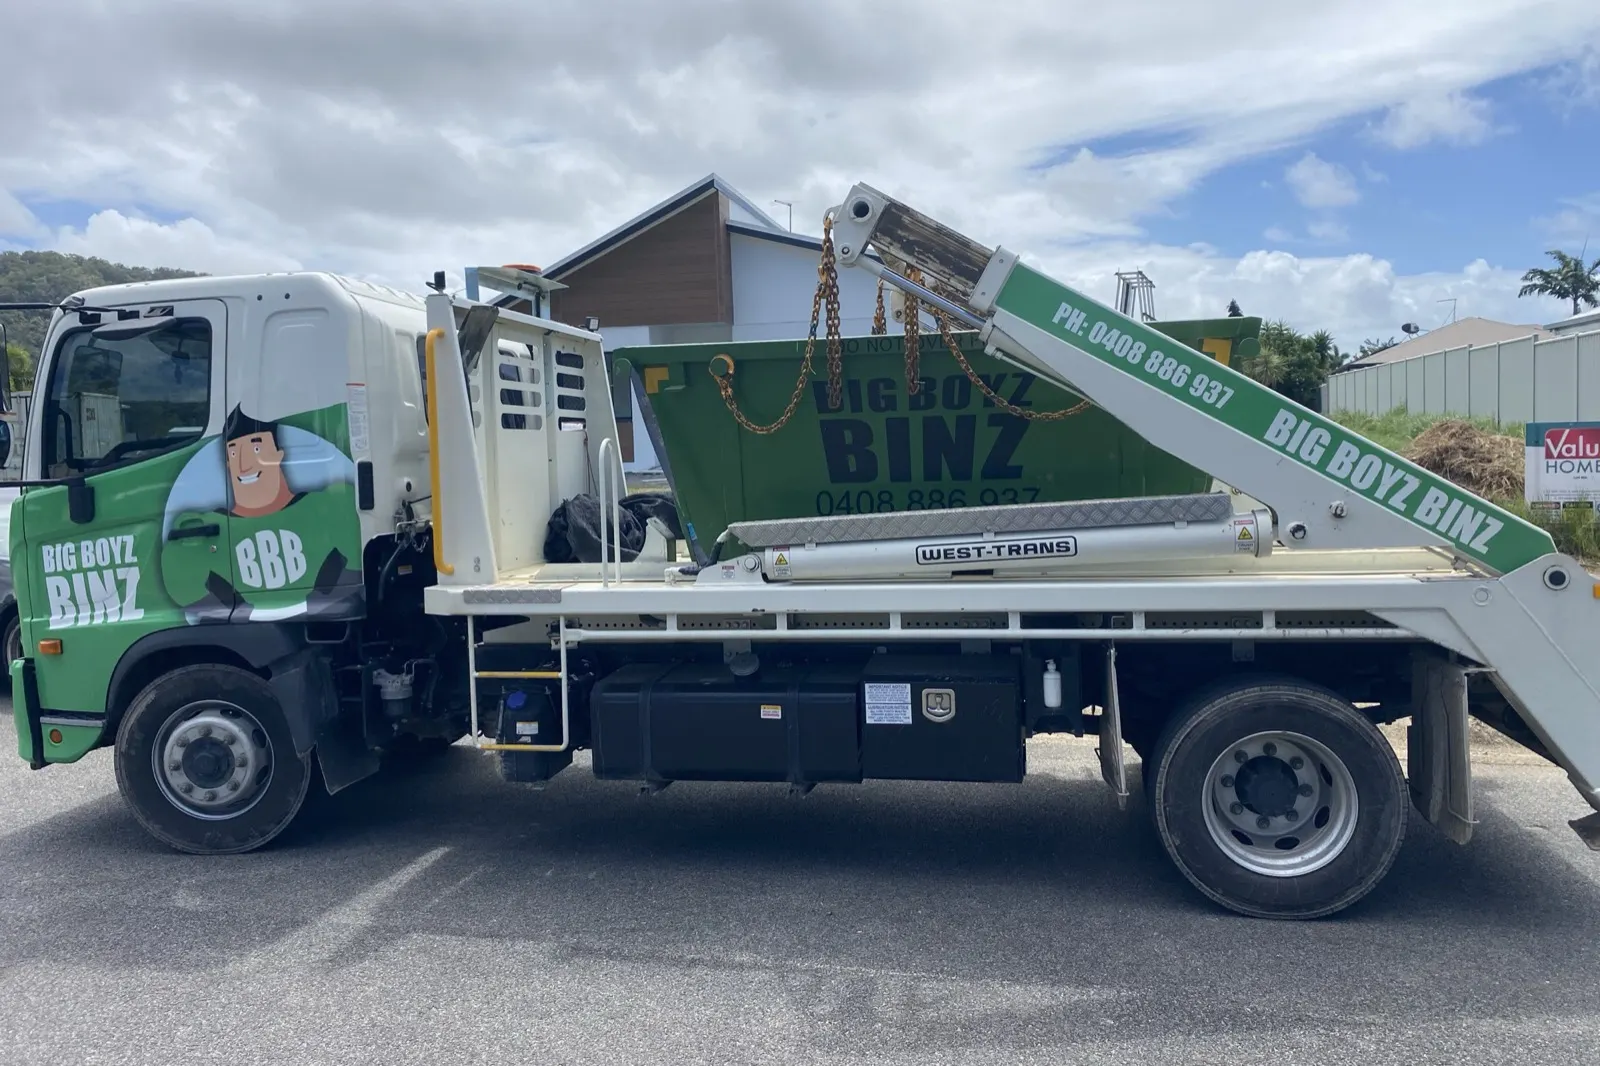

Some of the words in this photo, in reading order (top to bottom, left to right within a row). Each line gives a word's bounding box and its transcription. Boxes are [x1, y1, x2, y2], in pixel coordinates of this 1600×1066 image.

[867, 336, 907, 352] NOT
[1052, 302, 1088, 336] PH:
[1088, 321, 1147, 364] 0408
[1144, 350, 1191, 388] 886
[1189, 374, 1235, 409] 937
[812, 378, 897, 414] BIG
[908, 372, 1036, 411] BOYZ
[819, 413, 1031, 484] BINZ
[816, 490, 895, 516] 0408
[907, 488, 966, 509] 886
[1264, 408, 1331, 465] BIG
[1325, 440, 1422, 512] BOYZ
[1413, 486, 1504, 555] BINZ
[42, 542, 77, 573] BIG
[80, 535, 137, 568] BOYZ
[235, 529, 307, 589] BBB
[922, 541, 1071, 561] WEST-TRANS
[46, 567, 144, 629] BINZ
